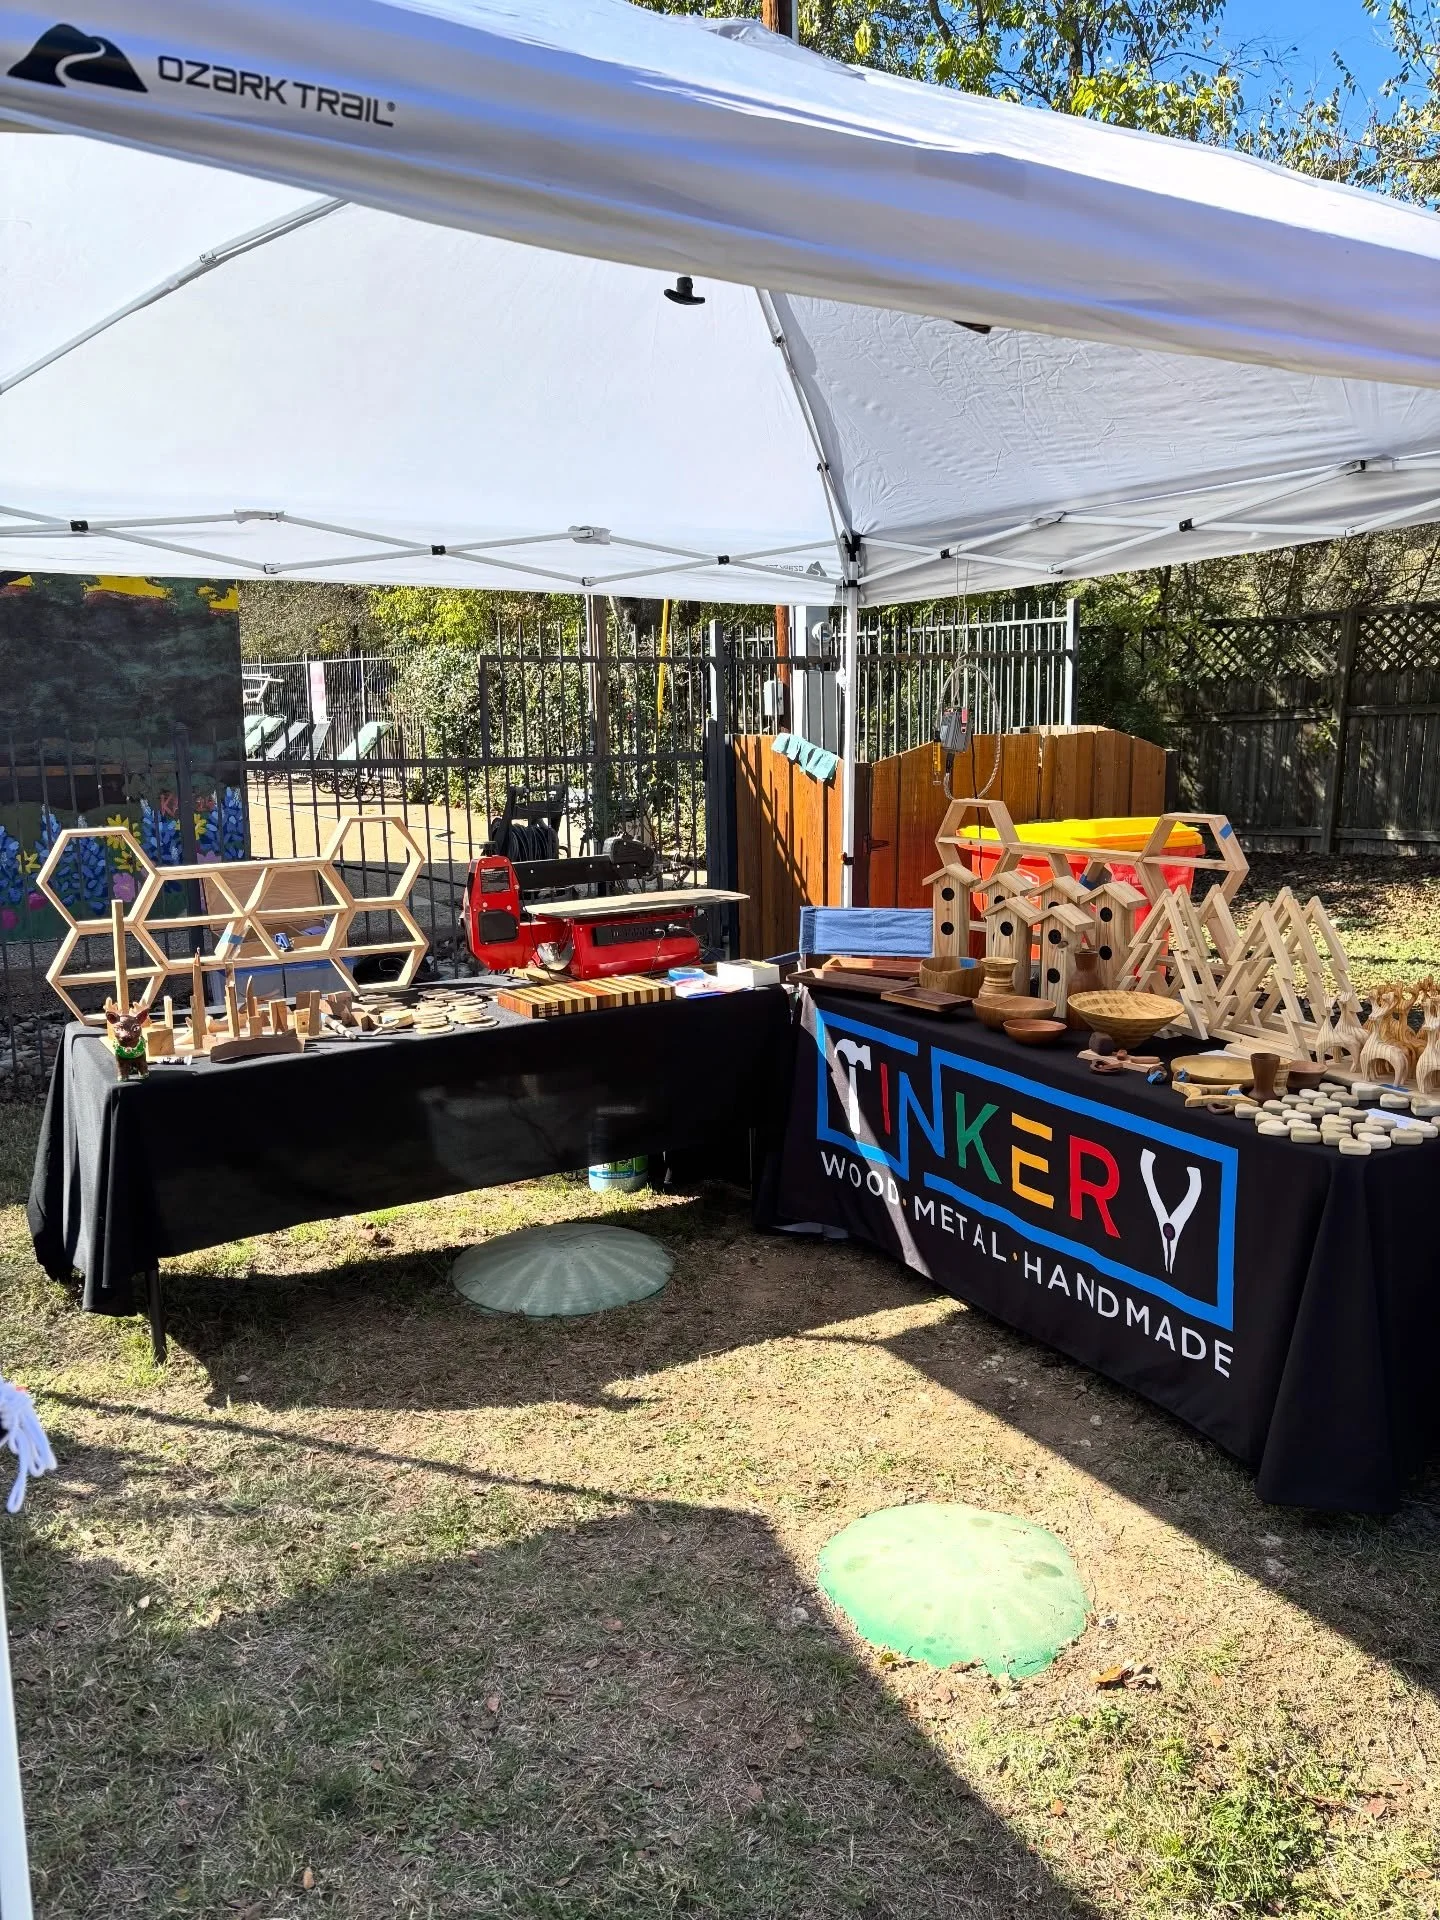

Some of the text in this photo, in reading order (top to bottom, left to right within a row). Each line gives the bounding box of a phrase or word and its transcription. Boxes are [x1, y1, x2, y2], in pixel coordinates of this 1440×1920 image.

[820, 1151, 1235, 1378] WOOD METAL HANDMADE
[833, 1038, 1203, 1274] TINKERY
